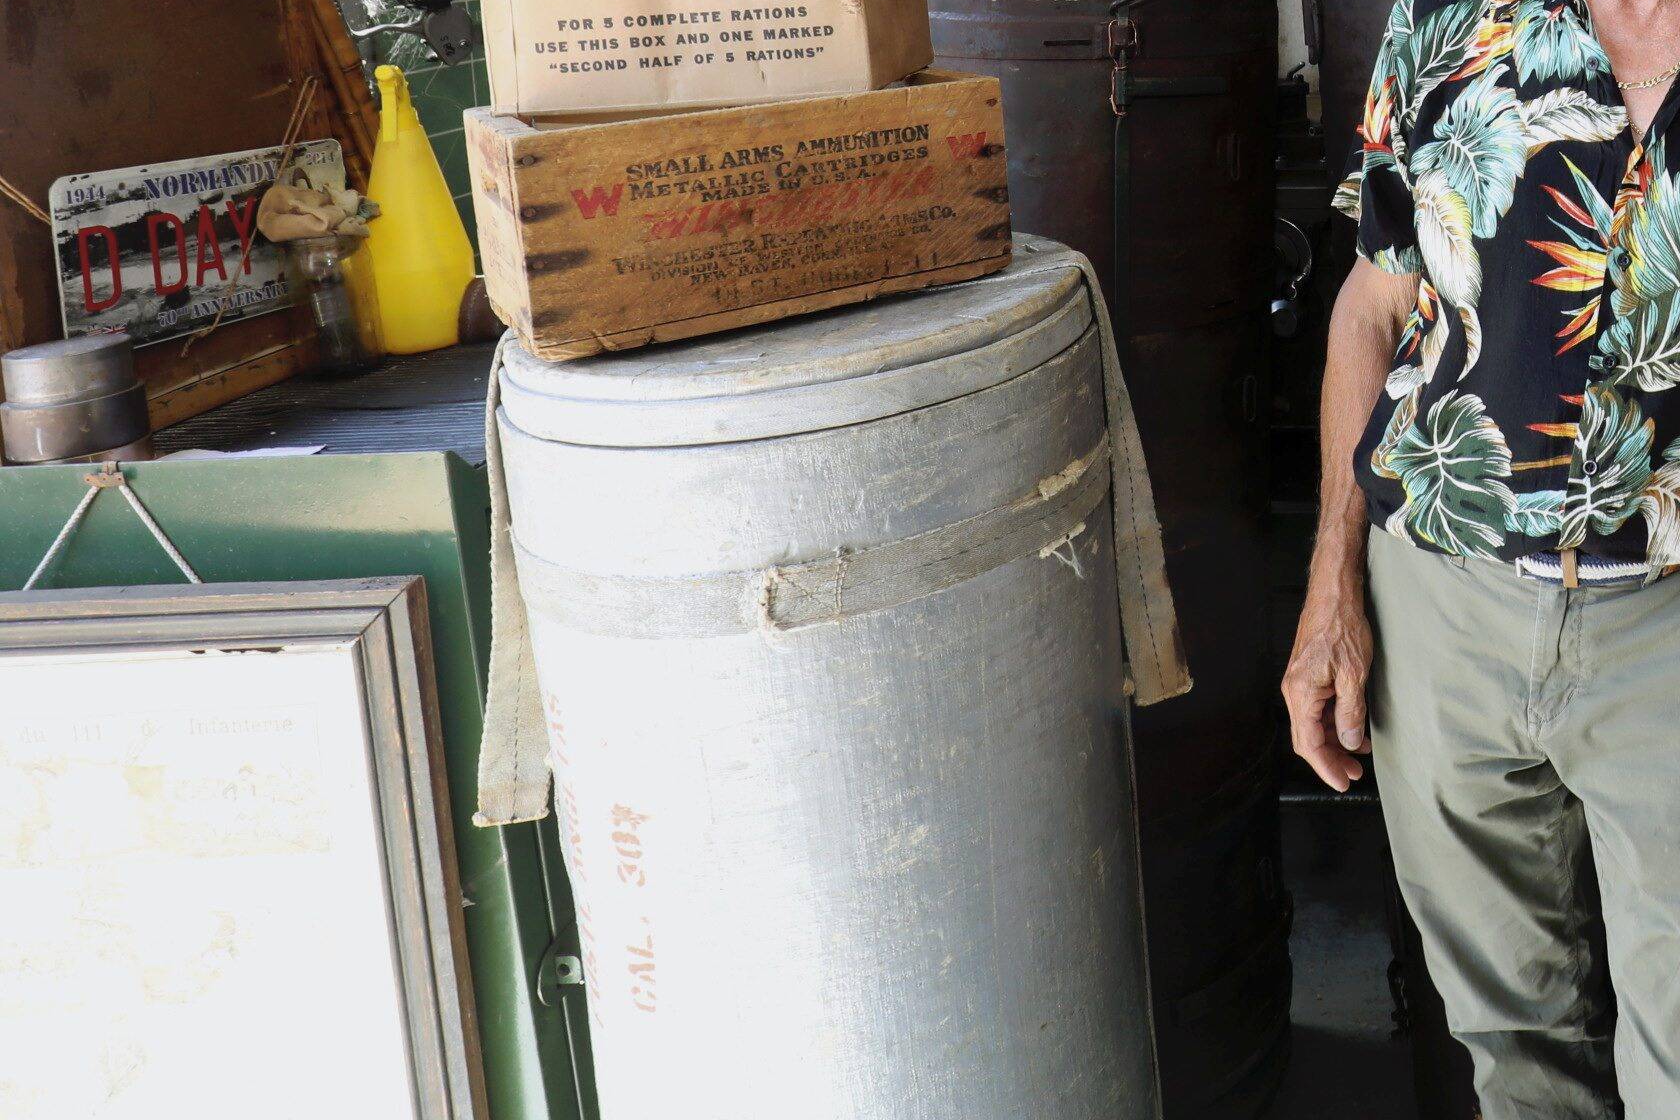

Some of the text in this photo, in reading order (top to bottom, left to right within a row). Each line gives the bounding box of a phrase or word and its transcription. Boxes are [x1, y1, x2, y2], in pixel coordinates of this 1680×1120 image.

[557, 6, 808, 32] FOR 5 COMPLETE RATIONS
[534, 24, 835, 54] USE THIS BOX AND ONE MARKED
[638, 55, 684, 69] HALF
[693, 52, 715, 66] OF
[725, 51, 736, 63] 5
[625, 123, 930, 181] SMALL ARMS AMMUNITION
[945, 130, 989, 161] W
[65, 186, 107, 207] 1944
[142, 159, 281, 202] NORMANDY
[628, 145, 929, 202] METALLIC CARTRIDGES
[701, 181, 772, 203] MADE
[779, 177, 801, 193] IN
[570, 183, 625, 221] W
[78, 195, 259, 313] D DAY
